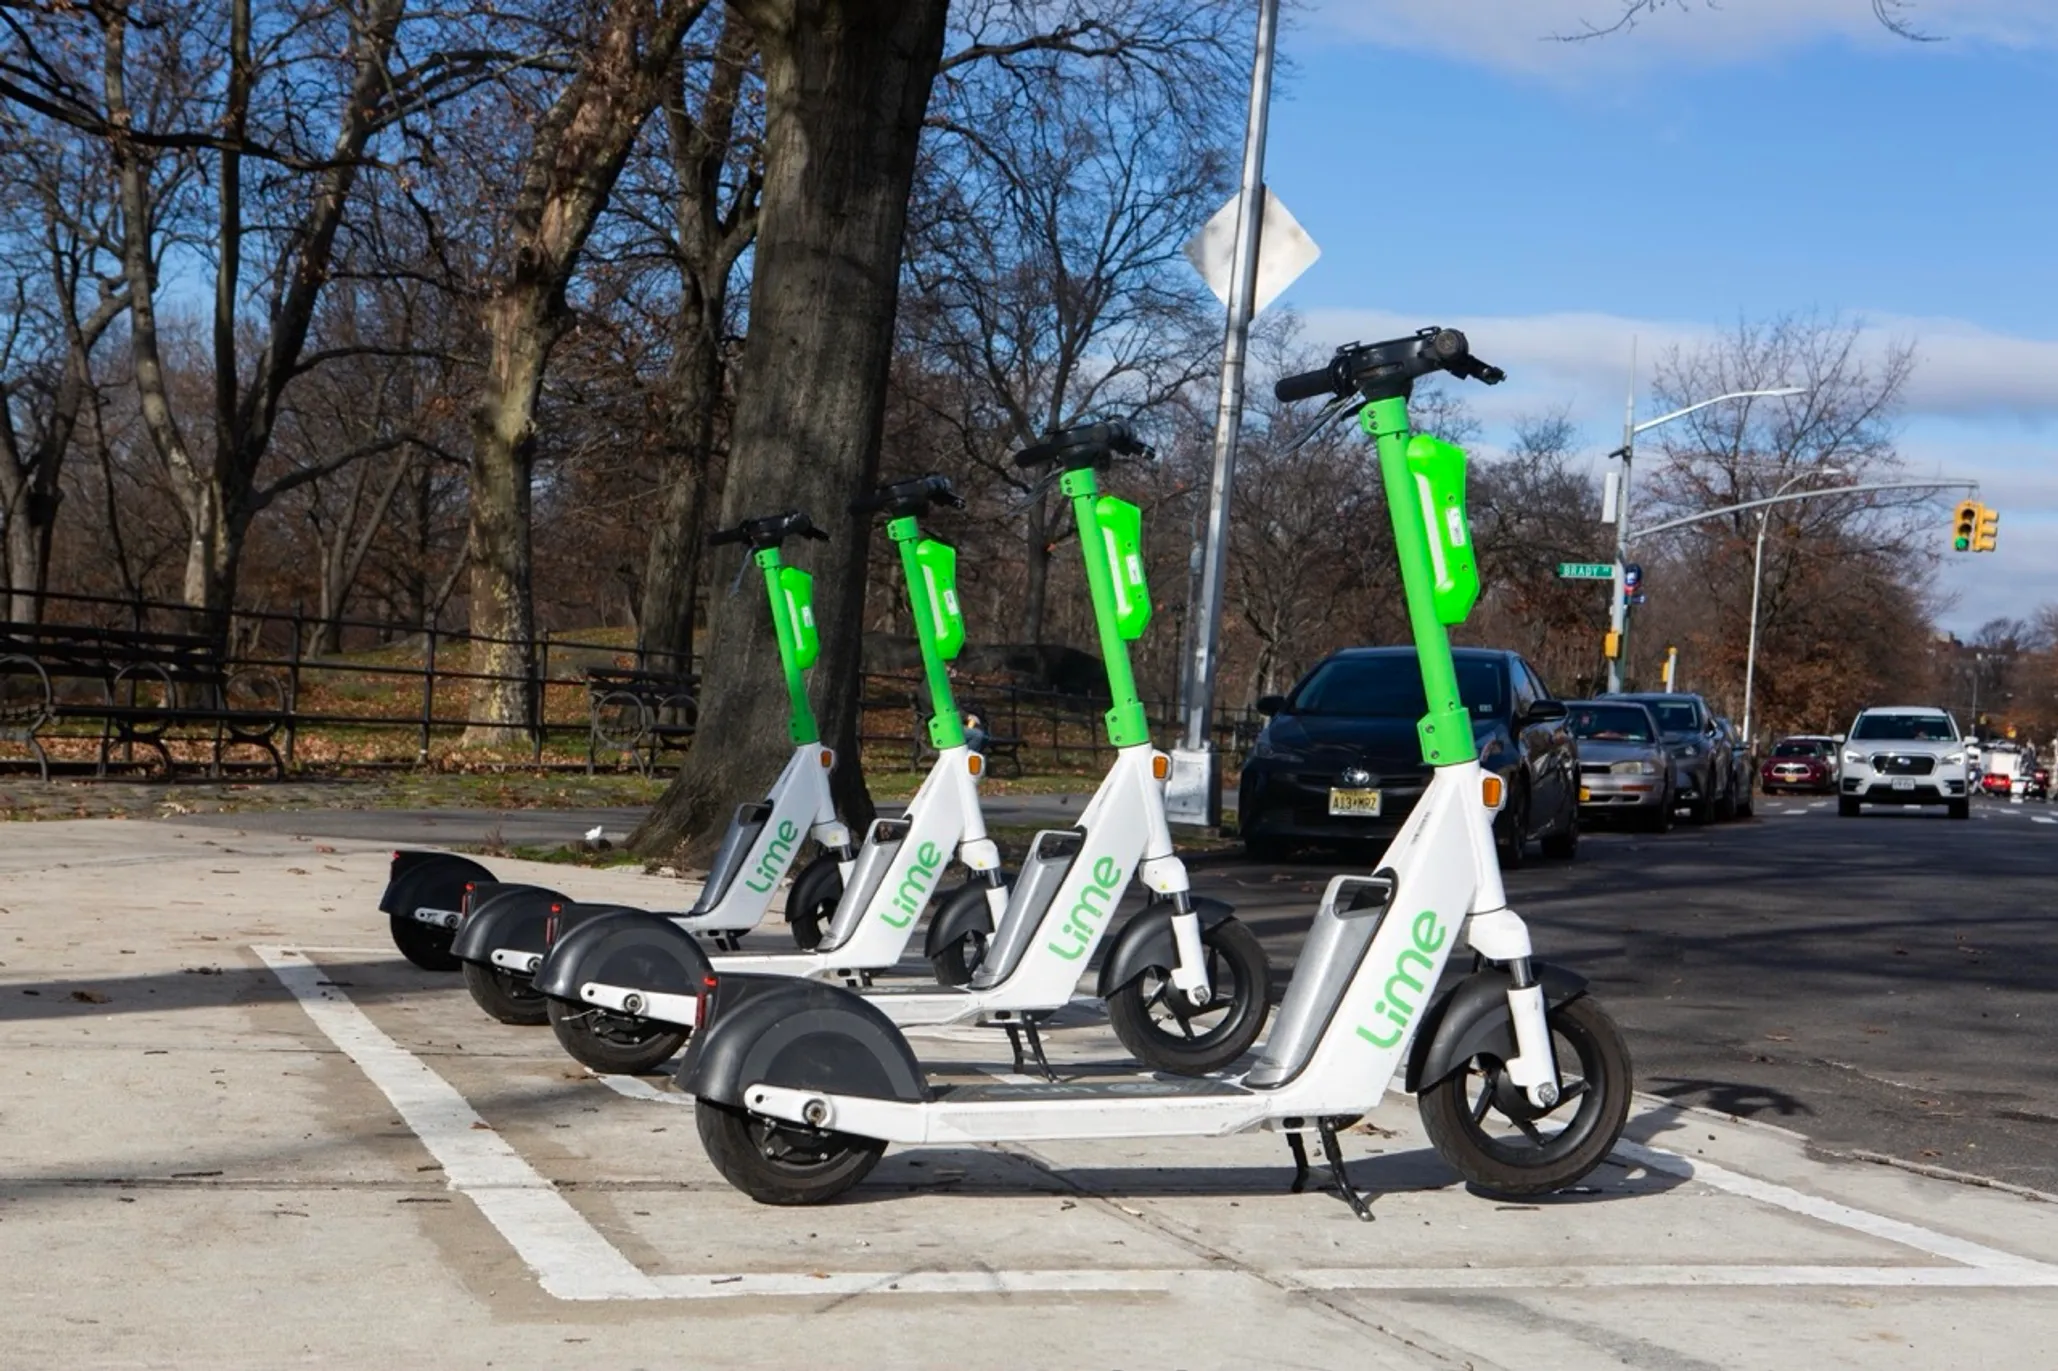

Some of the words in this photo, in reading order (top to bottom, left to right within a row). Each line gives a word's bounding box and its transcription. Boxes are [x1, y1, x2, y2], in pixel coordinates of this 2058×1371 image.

[1564, 565, 1598, 577] BRADY
[745, 819, 799, 894] Lime
[880, 840, 942, 929] Lime
[1048, 855, 1122, 960] Lime
[1356, 909, 1446, 1048] Lime
